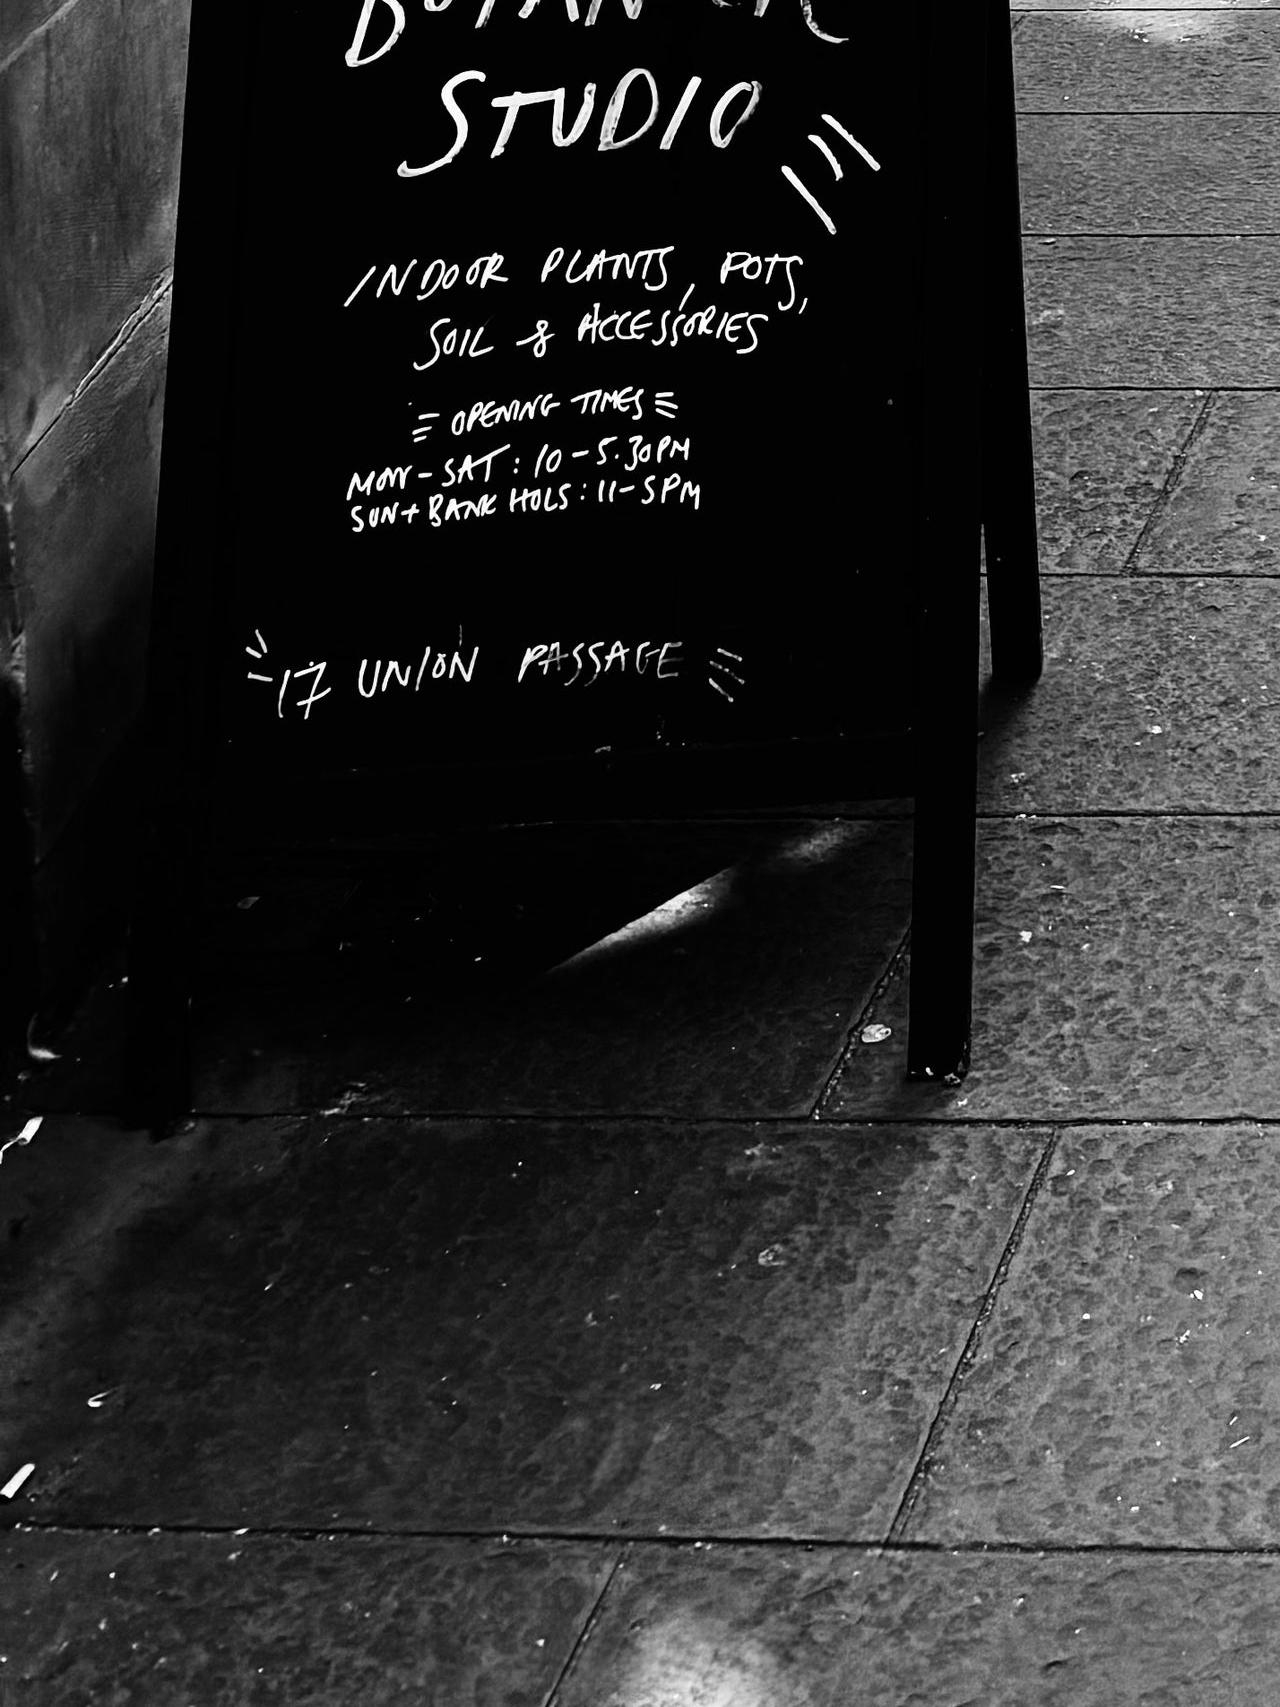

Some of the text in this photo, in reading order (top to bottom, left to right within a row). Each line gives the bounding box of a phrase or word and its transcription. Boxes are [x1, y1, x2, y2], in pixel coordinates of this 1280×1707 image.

[396, 67, 764, 178] STUDIO
[344, 251, 509, 307] INDOOR
[412, 301, 769, 371] SOIL & ACCESSORIES
[451, 385, 645, 436] OPENING TIMES
[277, 640, 684, 720] 17 UNION PASSAGE
